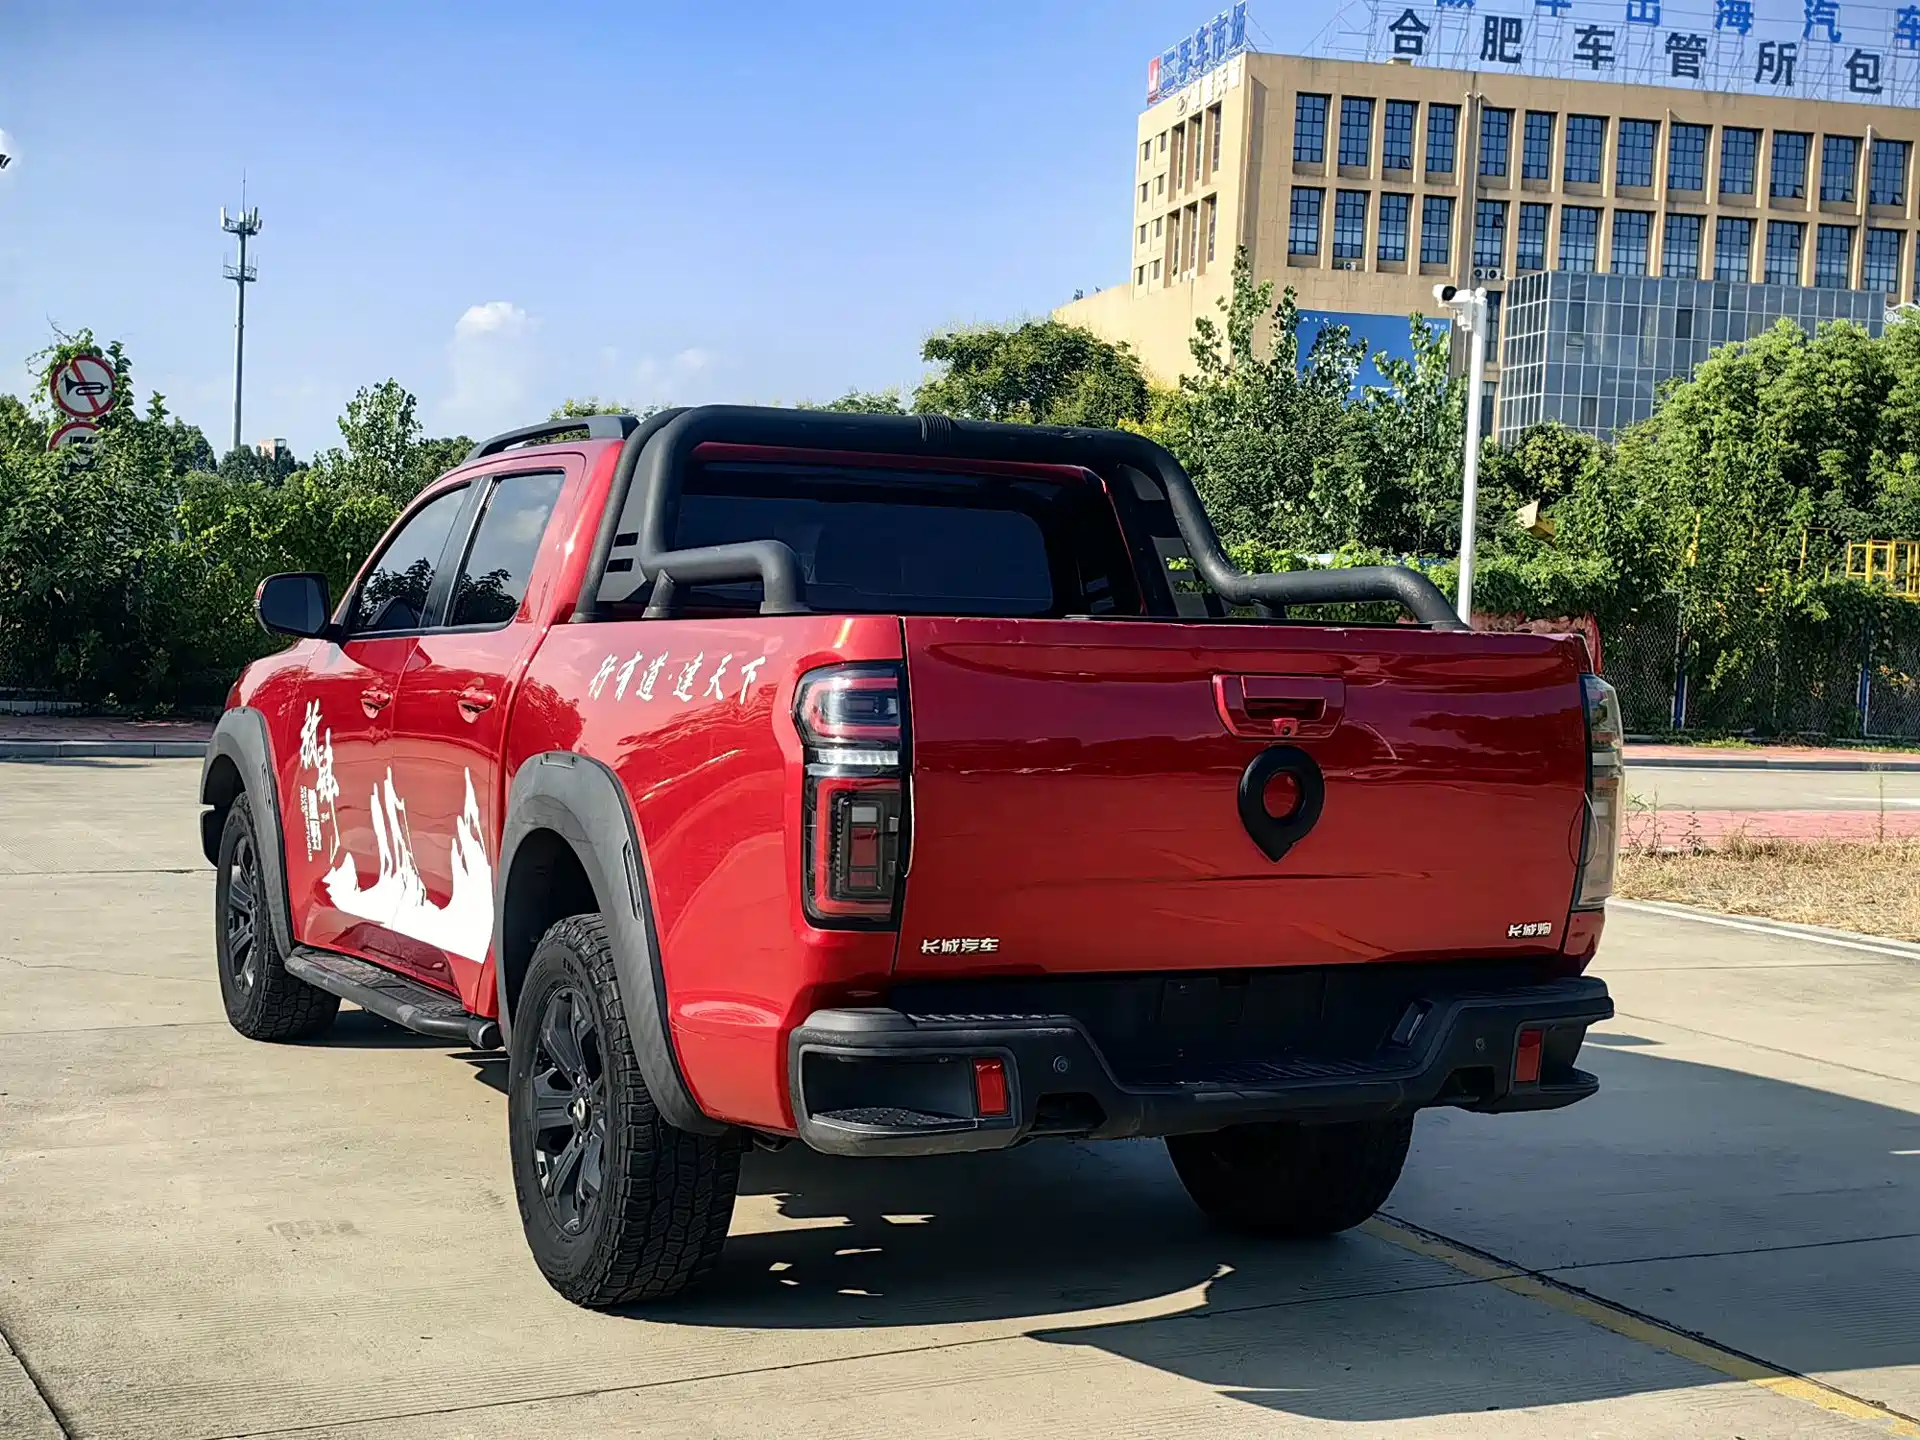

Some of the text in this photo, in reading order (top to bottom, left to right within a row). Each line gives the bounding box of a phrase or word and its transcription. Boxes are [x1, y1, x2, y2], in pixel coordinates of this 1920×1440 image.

[1388, 8, 1883, 94] 合肥车管所包
[921, 938, 999, 954] 长城汽车
